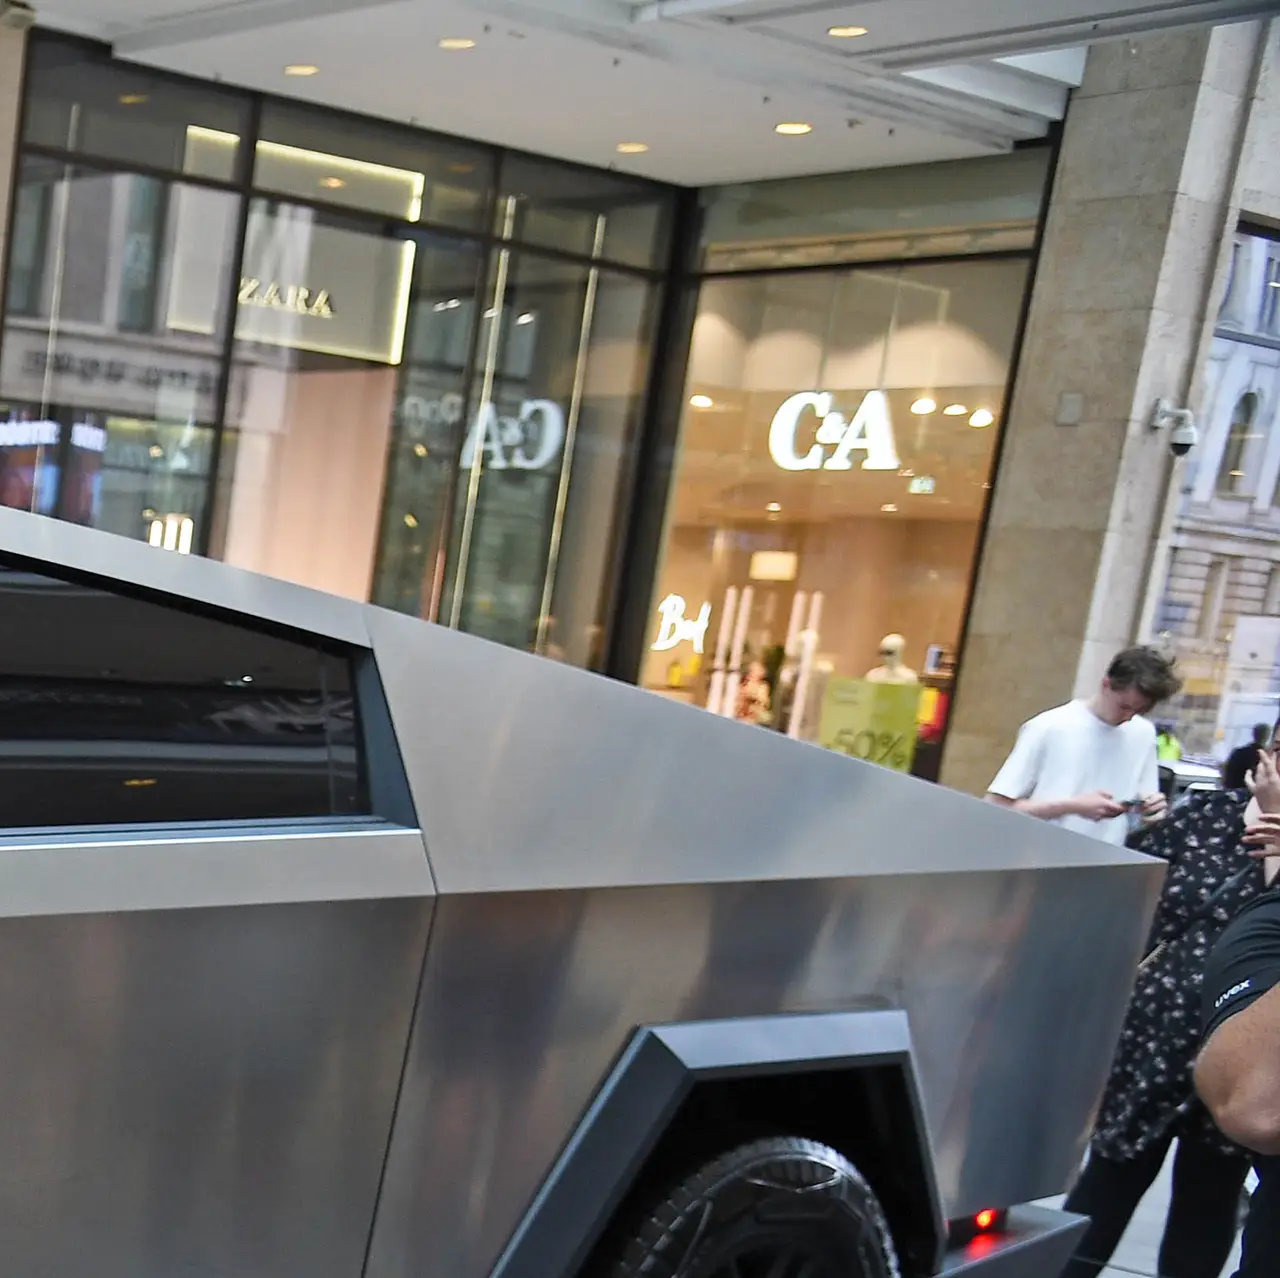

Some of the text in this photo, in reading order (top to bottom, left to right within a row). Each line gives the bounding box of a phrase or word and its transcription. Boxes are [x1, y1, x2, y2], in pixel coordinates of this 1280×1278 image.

[237, 278, 334, 319] ZARA
[768, 390, 900, 470] C&A
[1215, 979, 1251, 1007] uvex
